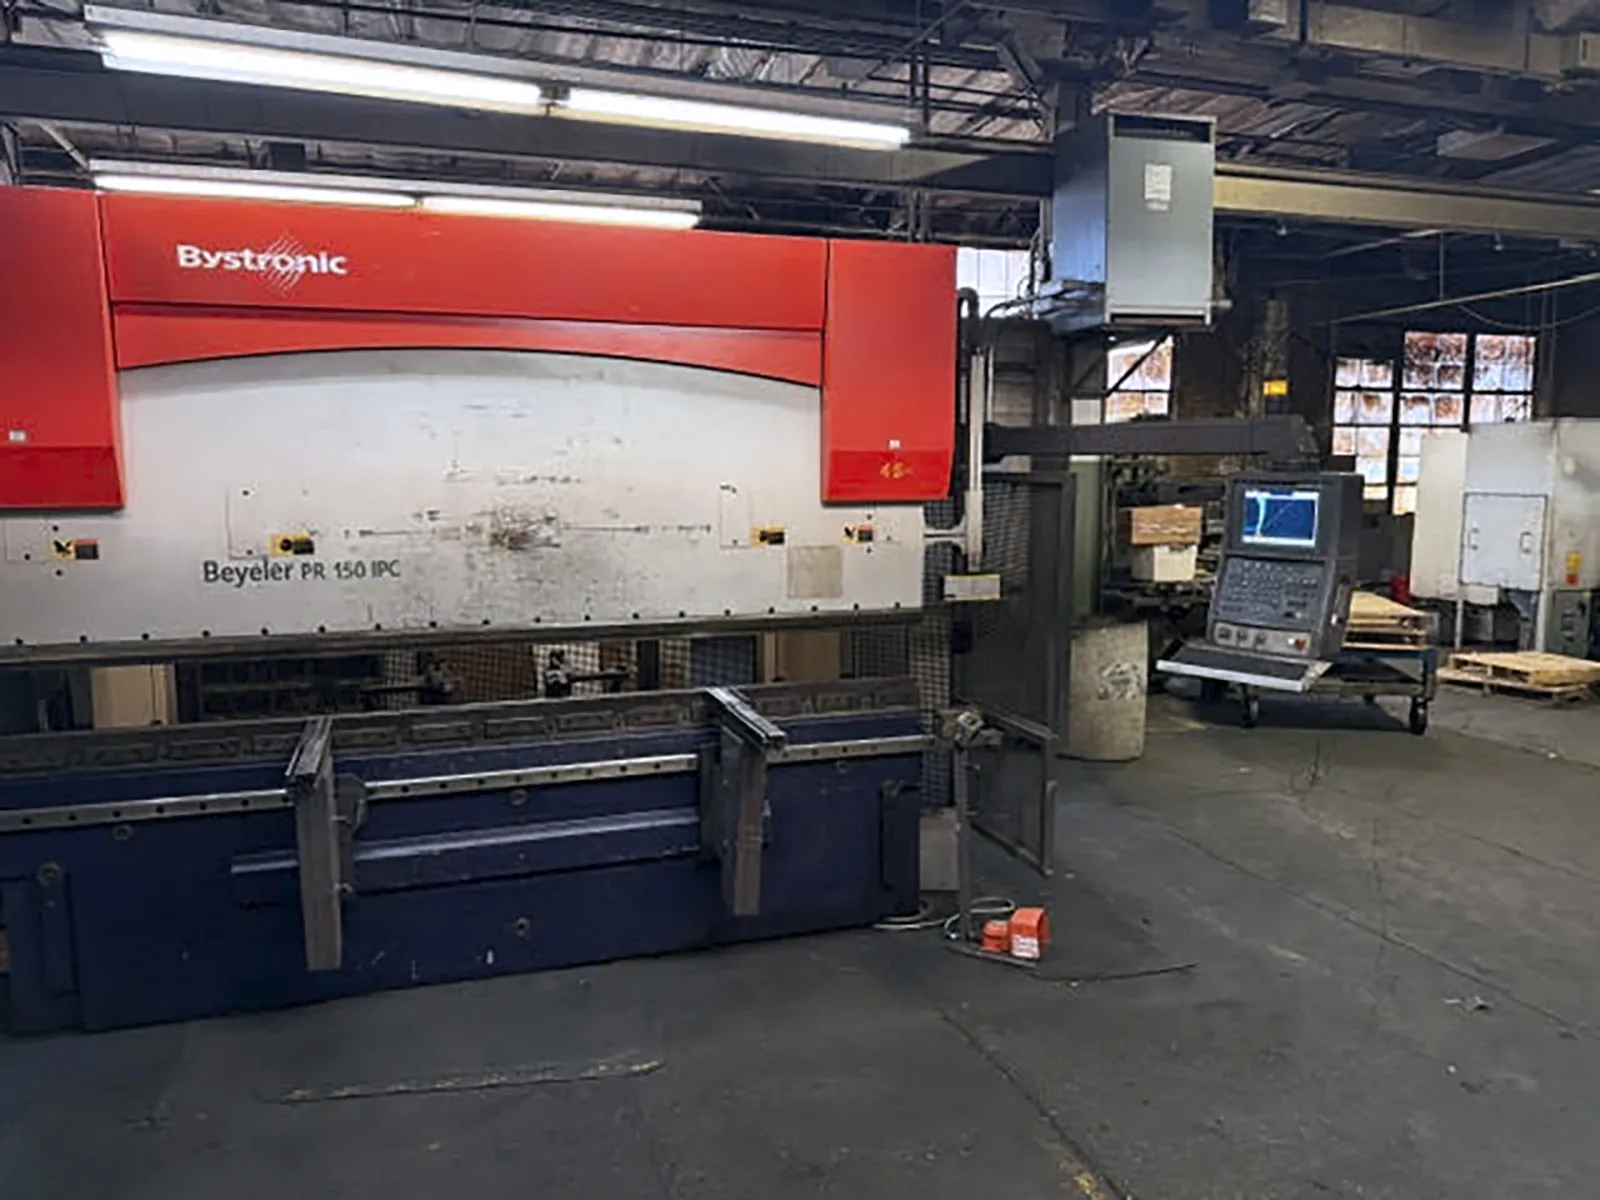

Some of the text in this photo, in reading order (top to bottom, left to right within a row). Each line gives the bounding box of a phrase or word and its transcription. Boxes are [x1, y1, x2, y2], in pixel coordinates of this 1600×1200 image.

[177, 244, 348, 275] Bystronic
[203, 555, 402, 588] Beyeler PR 150 IPC
